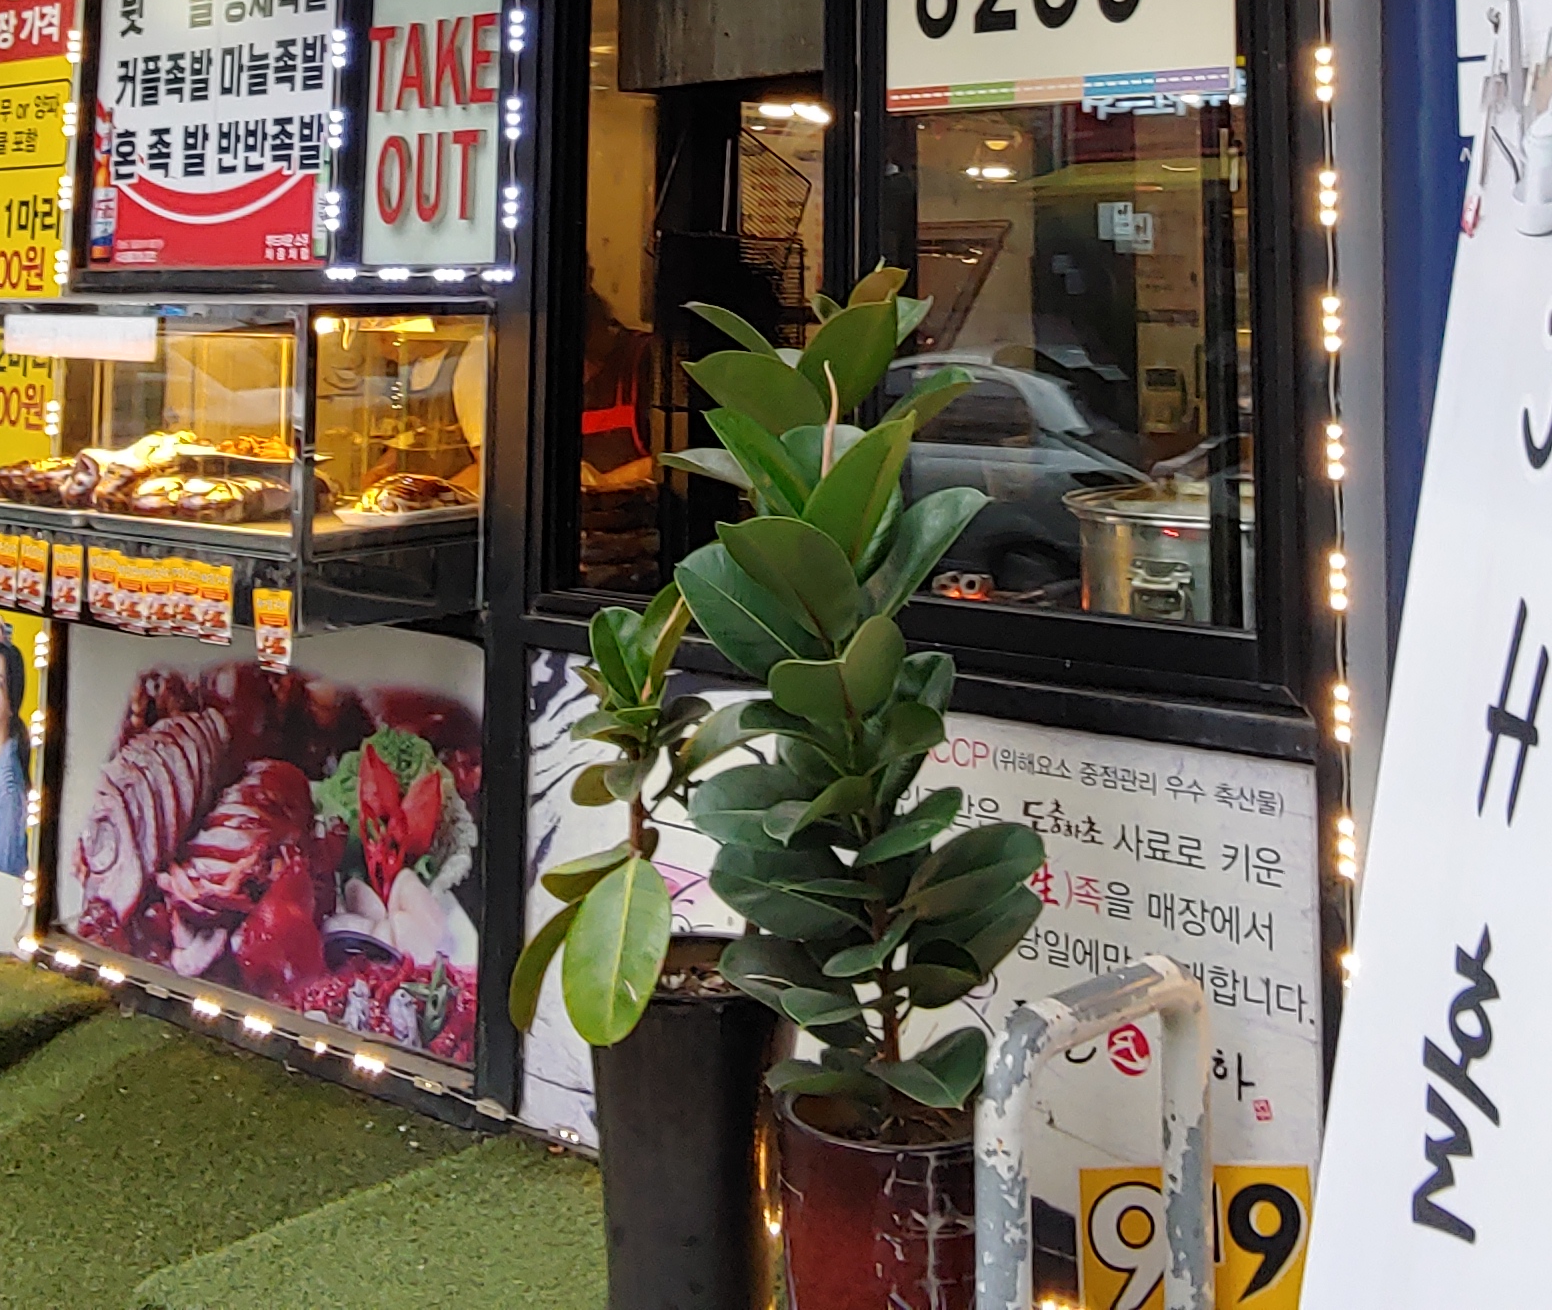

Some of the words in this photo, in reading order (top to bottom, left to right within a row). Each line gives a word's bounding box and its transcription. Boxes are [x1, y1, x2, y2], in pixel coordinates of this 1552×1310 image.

[19, 2, 61, 46] 가격
[115, 47, 213, 108] 커플족발
[219, 33, 328, 98] 마늘족발
[368, 12, 499, 112] TAKE
[216, 112, 325, 176] 반반족발
[376, 129, 480, 227] OUT
[928, 737, 990, 770] CCP
[1079, 760, 1158, 796] 중점관리
[1164, 774, 1207, 802] 우수
[1214, 781, 1285, 818] 축산물)
[1113, 823, 1207, 872] 사료로
[1221, 843, 1286, 889] 키운
[1147, 891, 1275, 952] 매장에서
